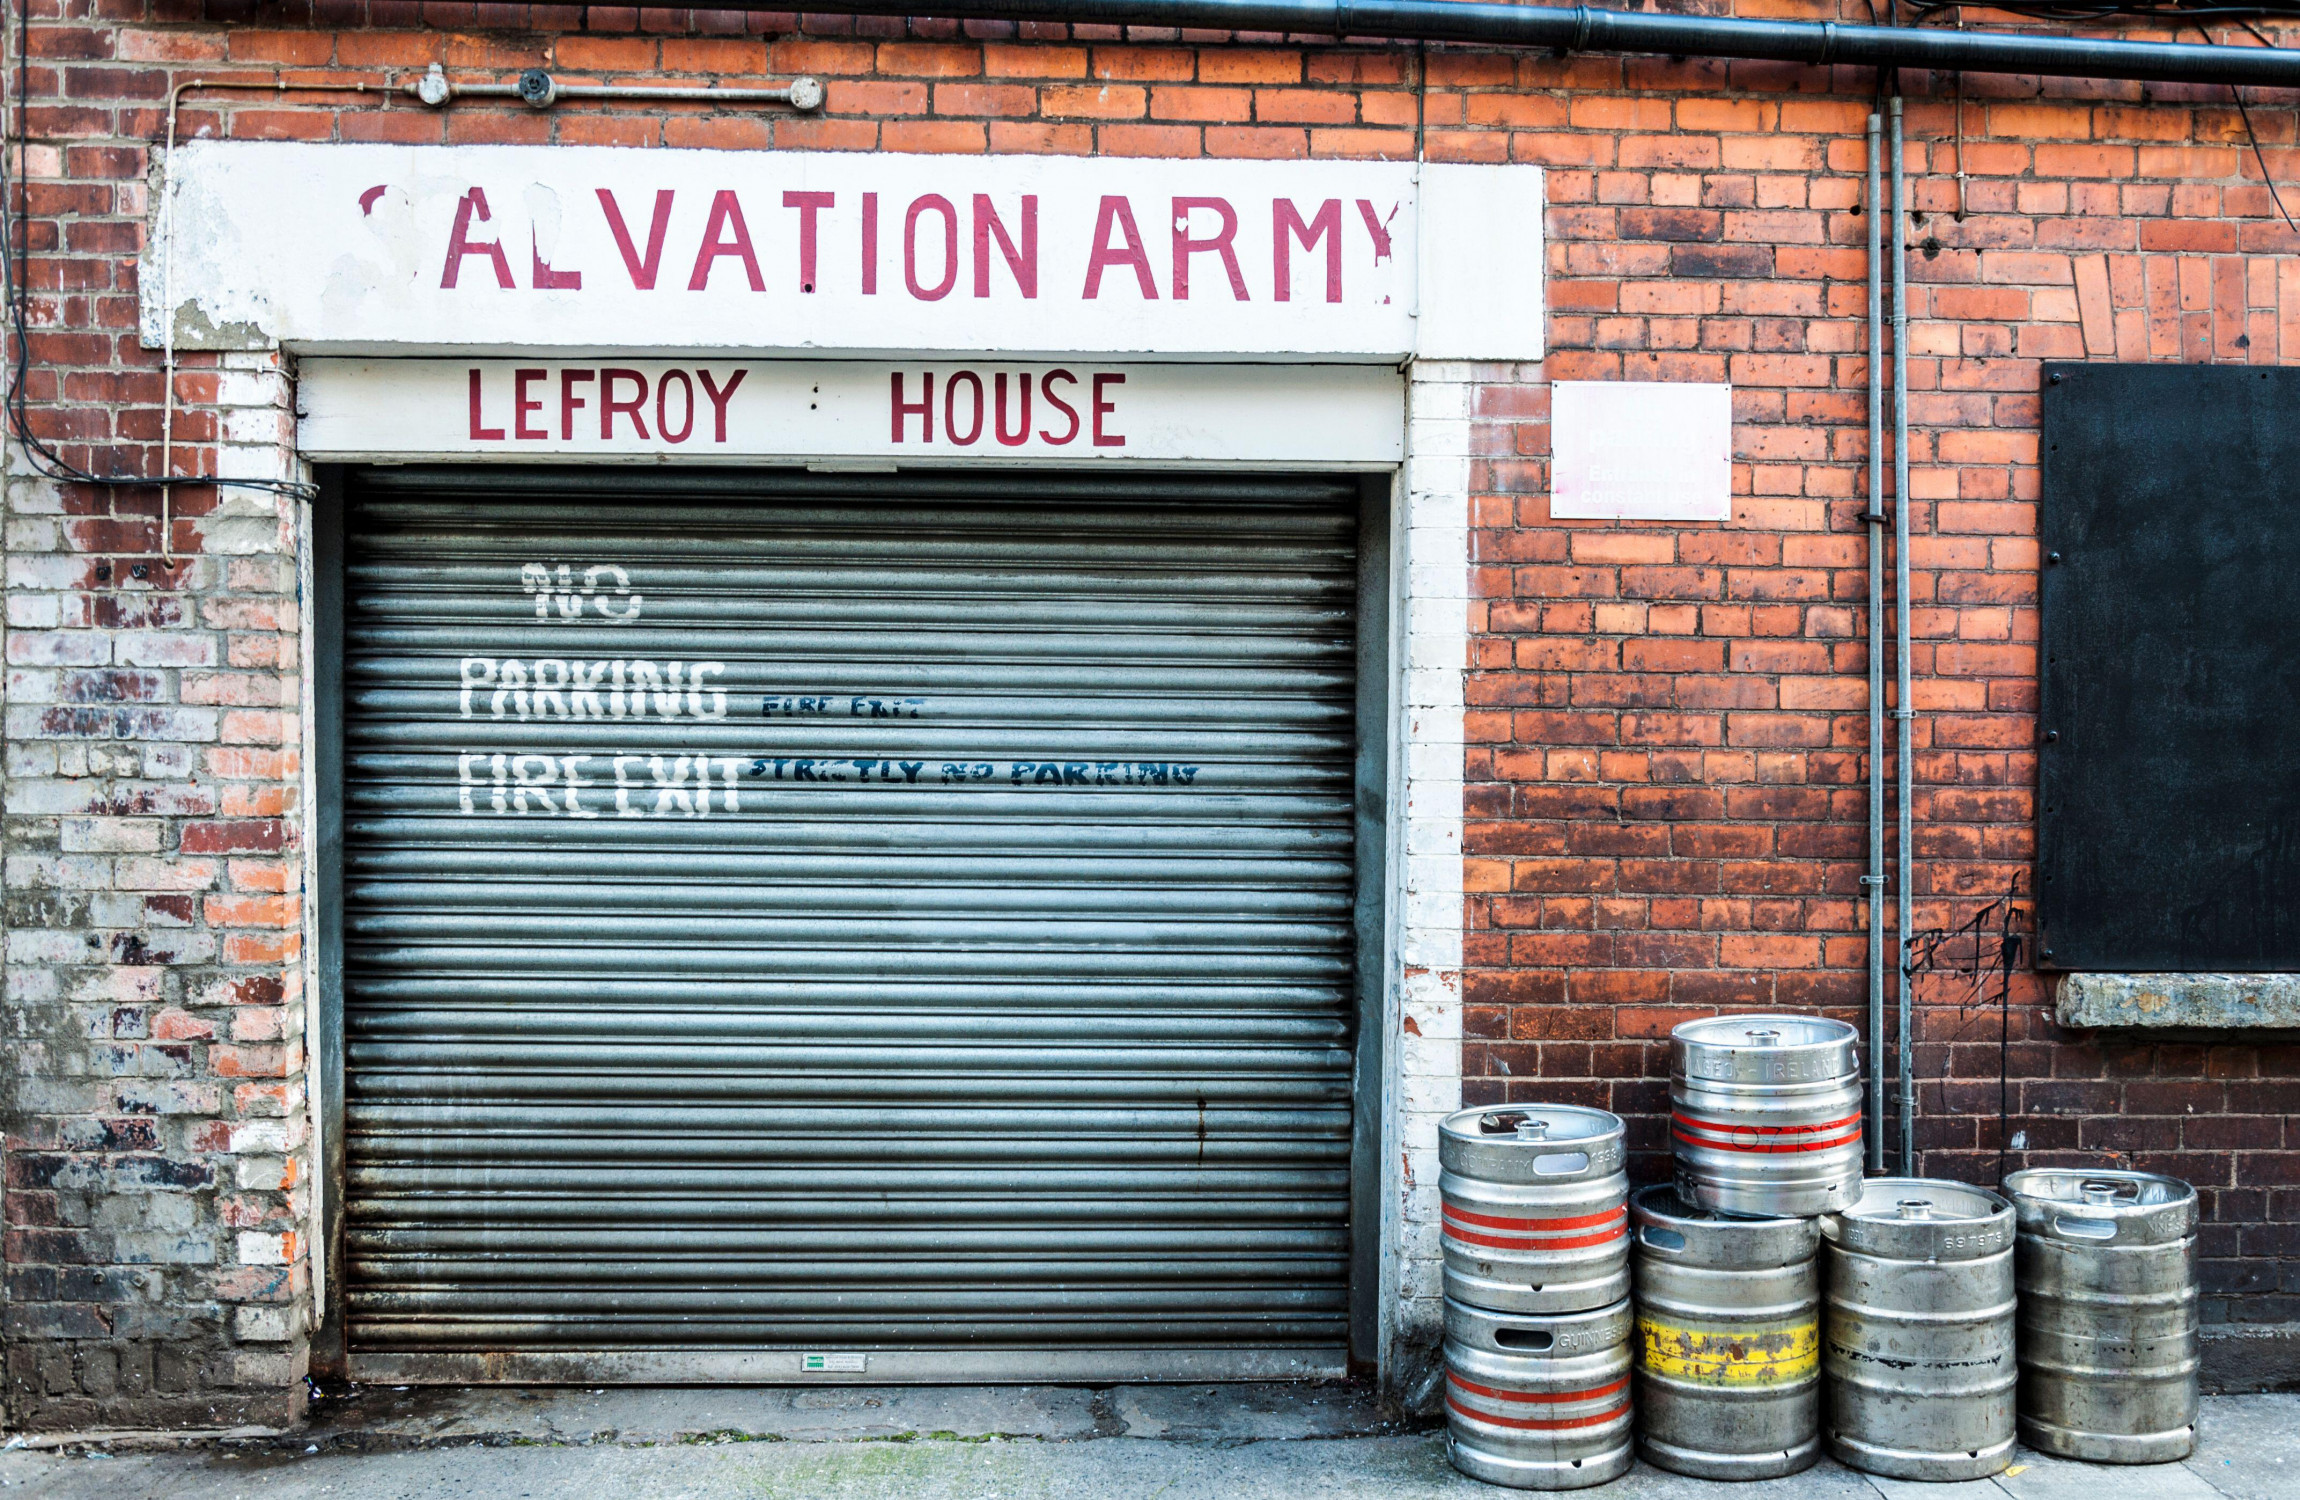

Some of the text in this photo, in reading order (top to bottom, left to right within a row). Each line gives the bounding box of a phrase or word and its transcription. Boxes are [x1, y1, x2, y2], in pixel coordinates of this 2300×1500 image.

[358, 184, 1399, 304] ALVATION ARMY
[468, 368, 1127, 447] LEFROY HOUSE
[521, 562, 643, 622] NO
[460, 657, 728, 721] PARKING
[458, 754, 748, 818] FIRE EXIT
[1010, 760, 1200, 787] PARKING
[1765, 1057, 1840, 1080] IRELAND
[1558, 1322, 1624, 1349] GUINNESS
